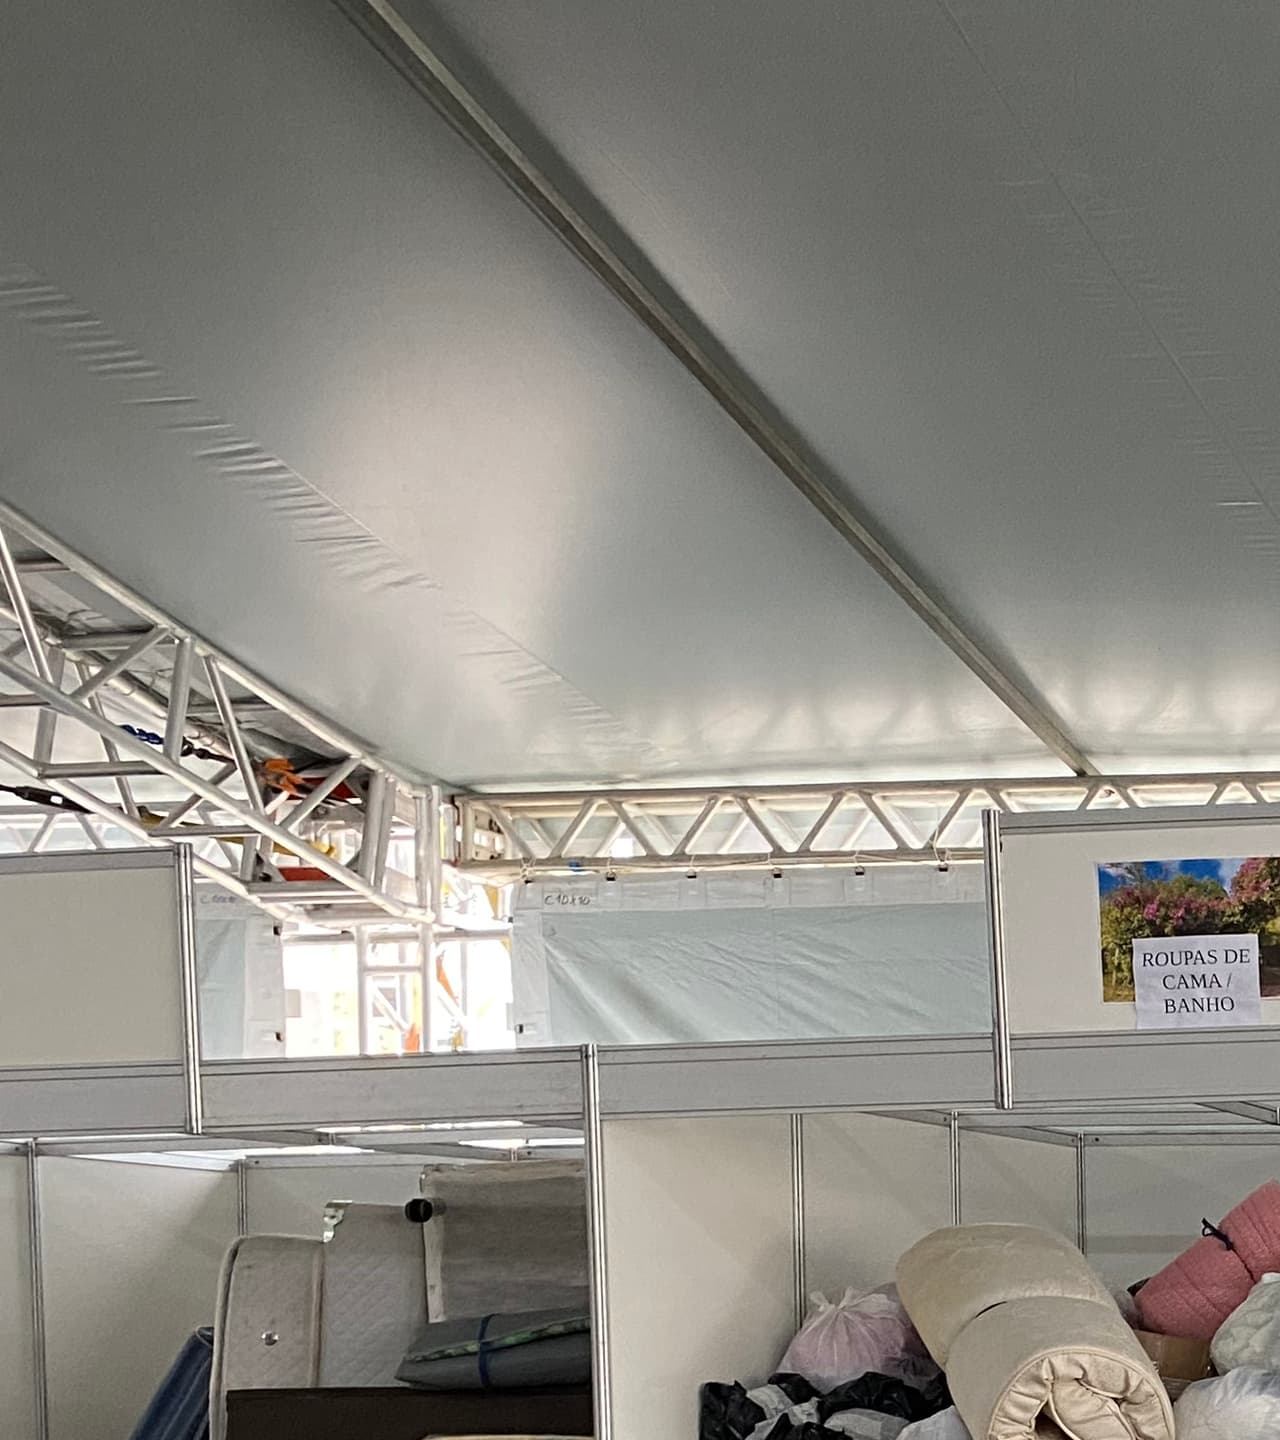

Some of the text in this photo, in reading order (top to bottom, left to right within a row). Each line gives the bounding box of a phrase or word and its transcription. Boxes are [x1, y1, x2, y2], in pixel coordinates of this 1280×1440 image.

[1142, 948, 1251, 967] ROUPAS DE
[1162, 972, 1232, 990] CAMA /
[1165, 996, 1235, 1014] BANHO
